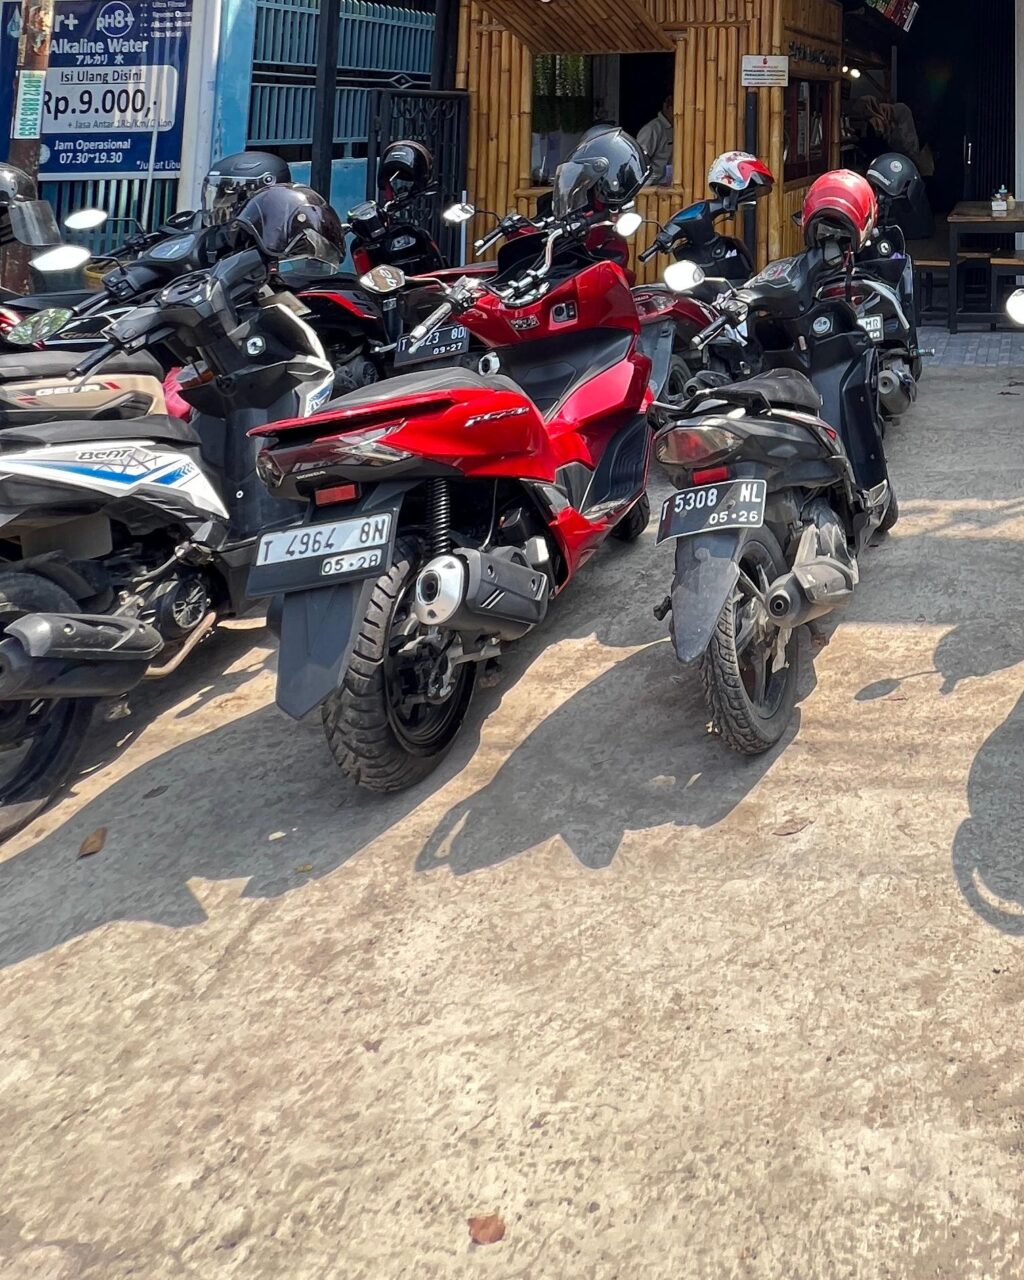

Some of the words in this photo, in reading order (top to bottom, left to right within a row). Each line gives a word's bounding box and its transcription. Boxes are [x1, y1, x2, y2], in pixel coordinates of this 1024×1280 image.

[50, 38, 105, 54] Alkaline
[107, 38, 149, 53] Water
[60, 71, 74, 82] Isi
[77, 70, 108, 84] Ulang
[112, 69, 143, 82] Disini
[54, 140, 74, 151] Jam
[75, 138, 131, 151] Operasional
[662, 501, 670, 521] T
[674, 488, 718, 513] 5308
[740, 483, 761, 503] NL
[263, 540, 275, 563] T
[285, 526, 337, 557] 4964
